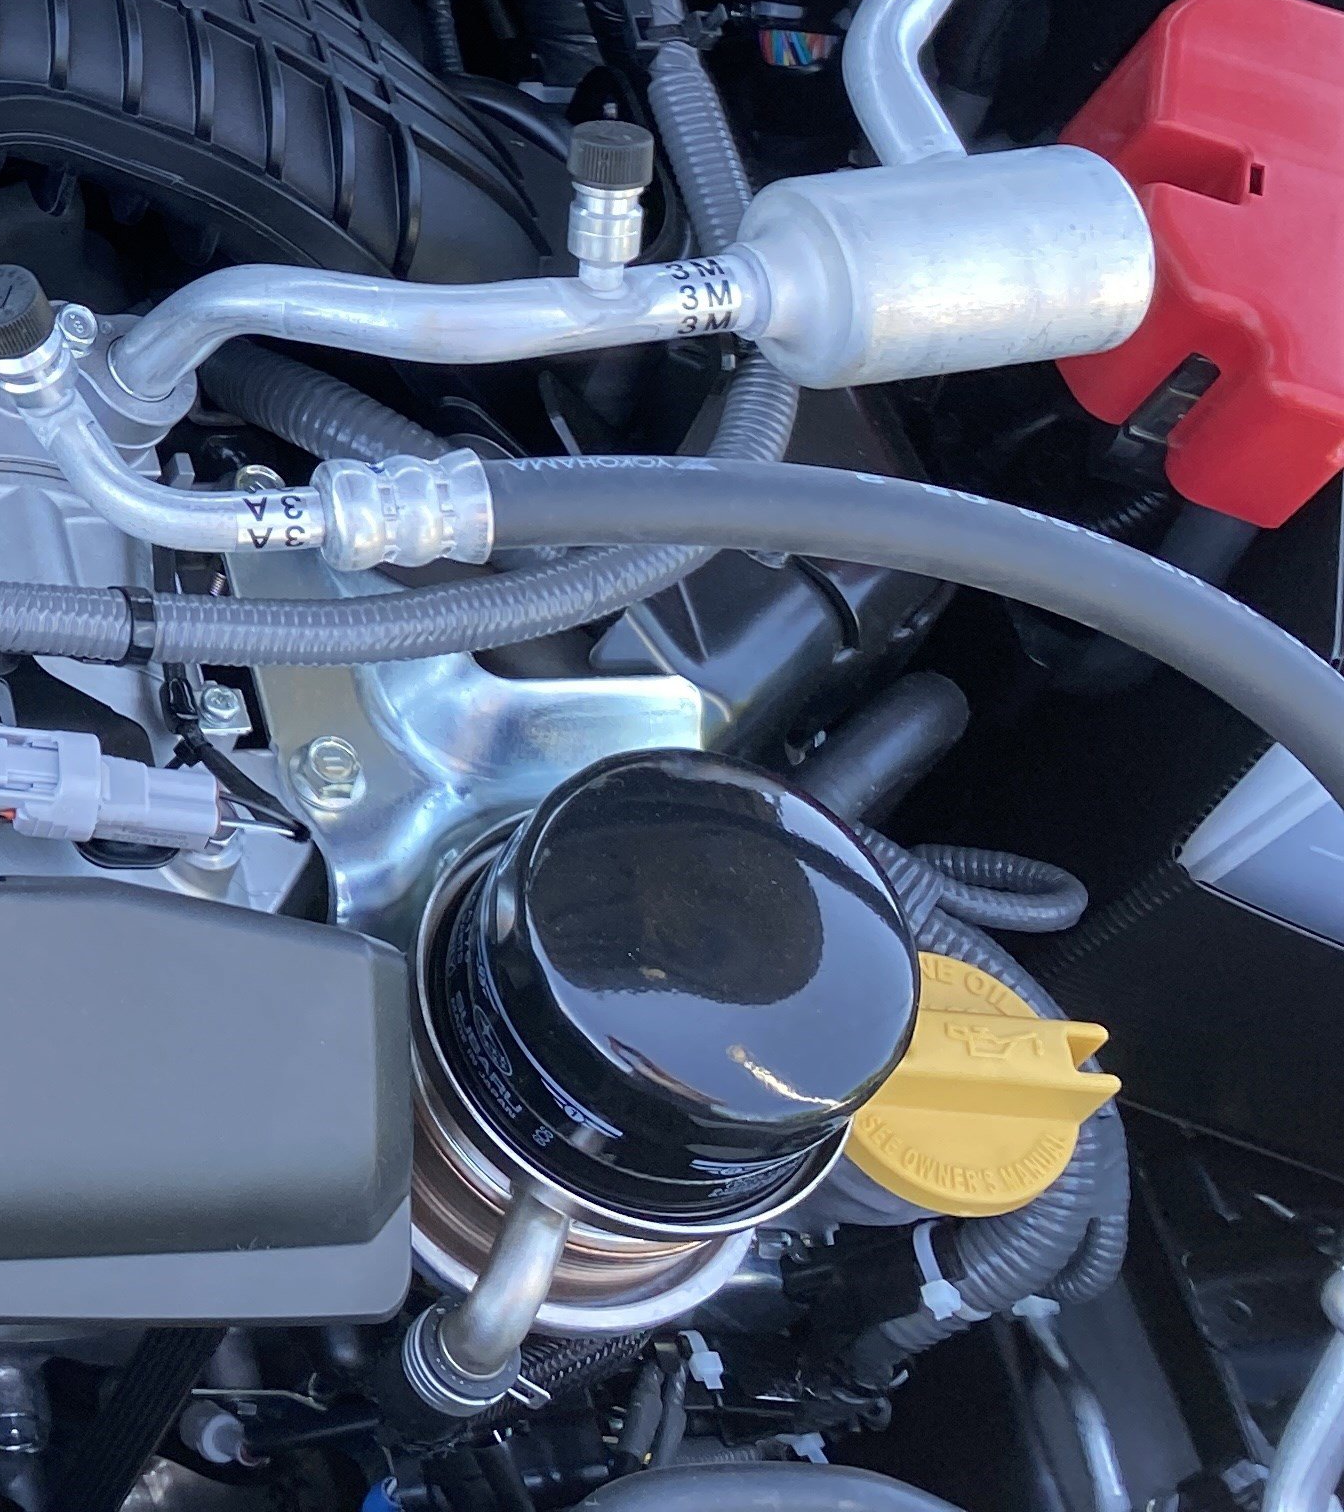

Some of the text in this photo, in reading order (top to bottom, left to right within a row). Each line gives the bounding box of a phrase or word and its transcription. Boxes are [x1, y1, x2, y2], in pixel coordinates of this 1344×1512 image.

[508, 456, 675, 471] YOKOHAMA
[455, 990, 523, 1113] SUBARU
[901, 1150, 994, 1194] OWNER'S
[999, 1133, 1070, 1191] MANUAL
